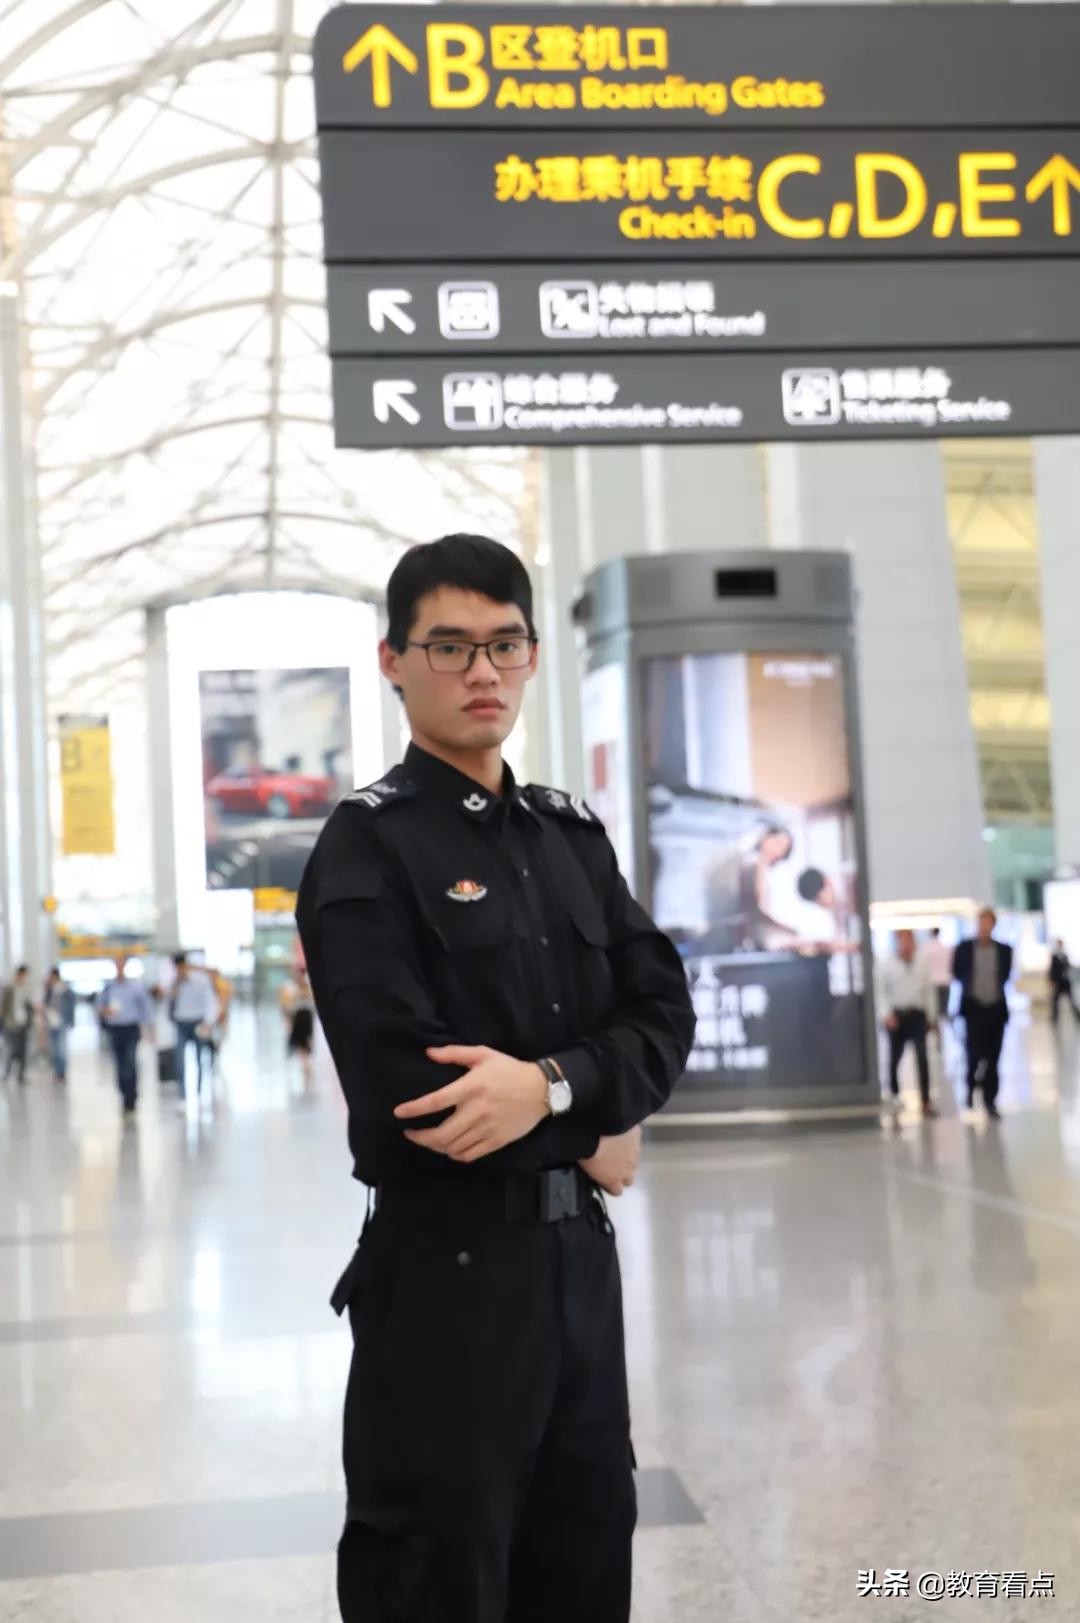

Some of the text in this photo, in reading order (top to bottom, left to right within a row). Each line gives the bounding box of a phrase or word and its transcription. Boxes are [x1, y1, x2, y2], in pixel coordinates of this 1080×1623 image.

[425, 22, 668, 109] B 区登机口
[495, 75, 826, 115] Area Boarding Gates
[495, 154, 753, 202] 办理乘机手续
[619, 204, 756, 240] Check-in
